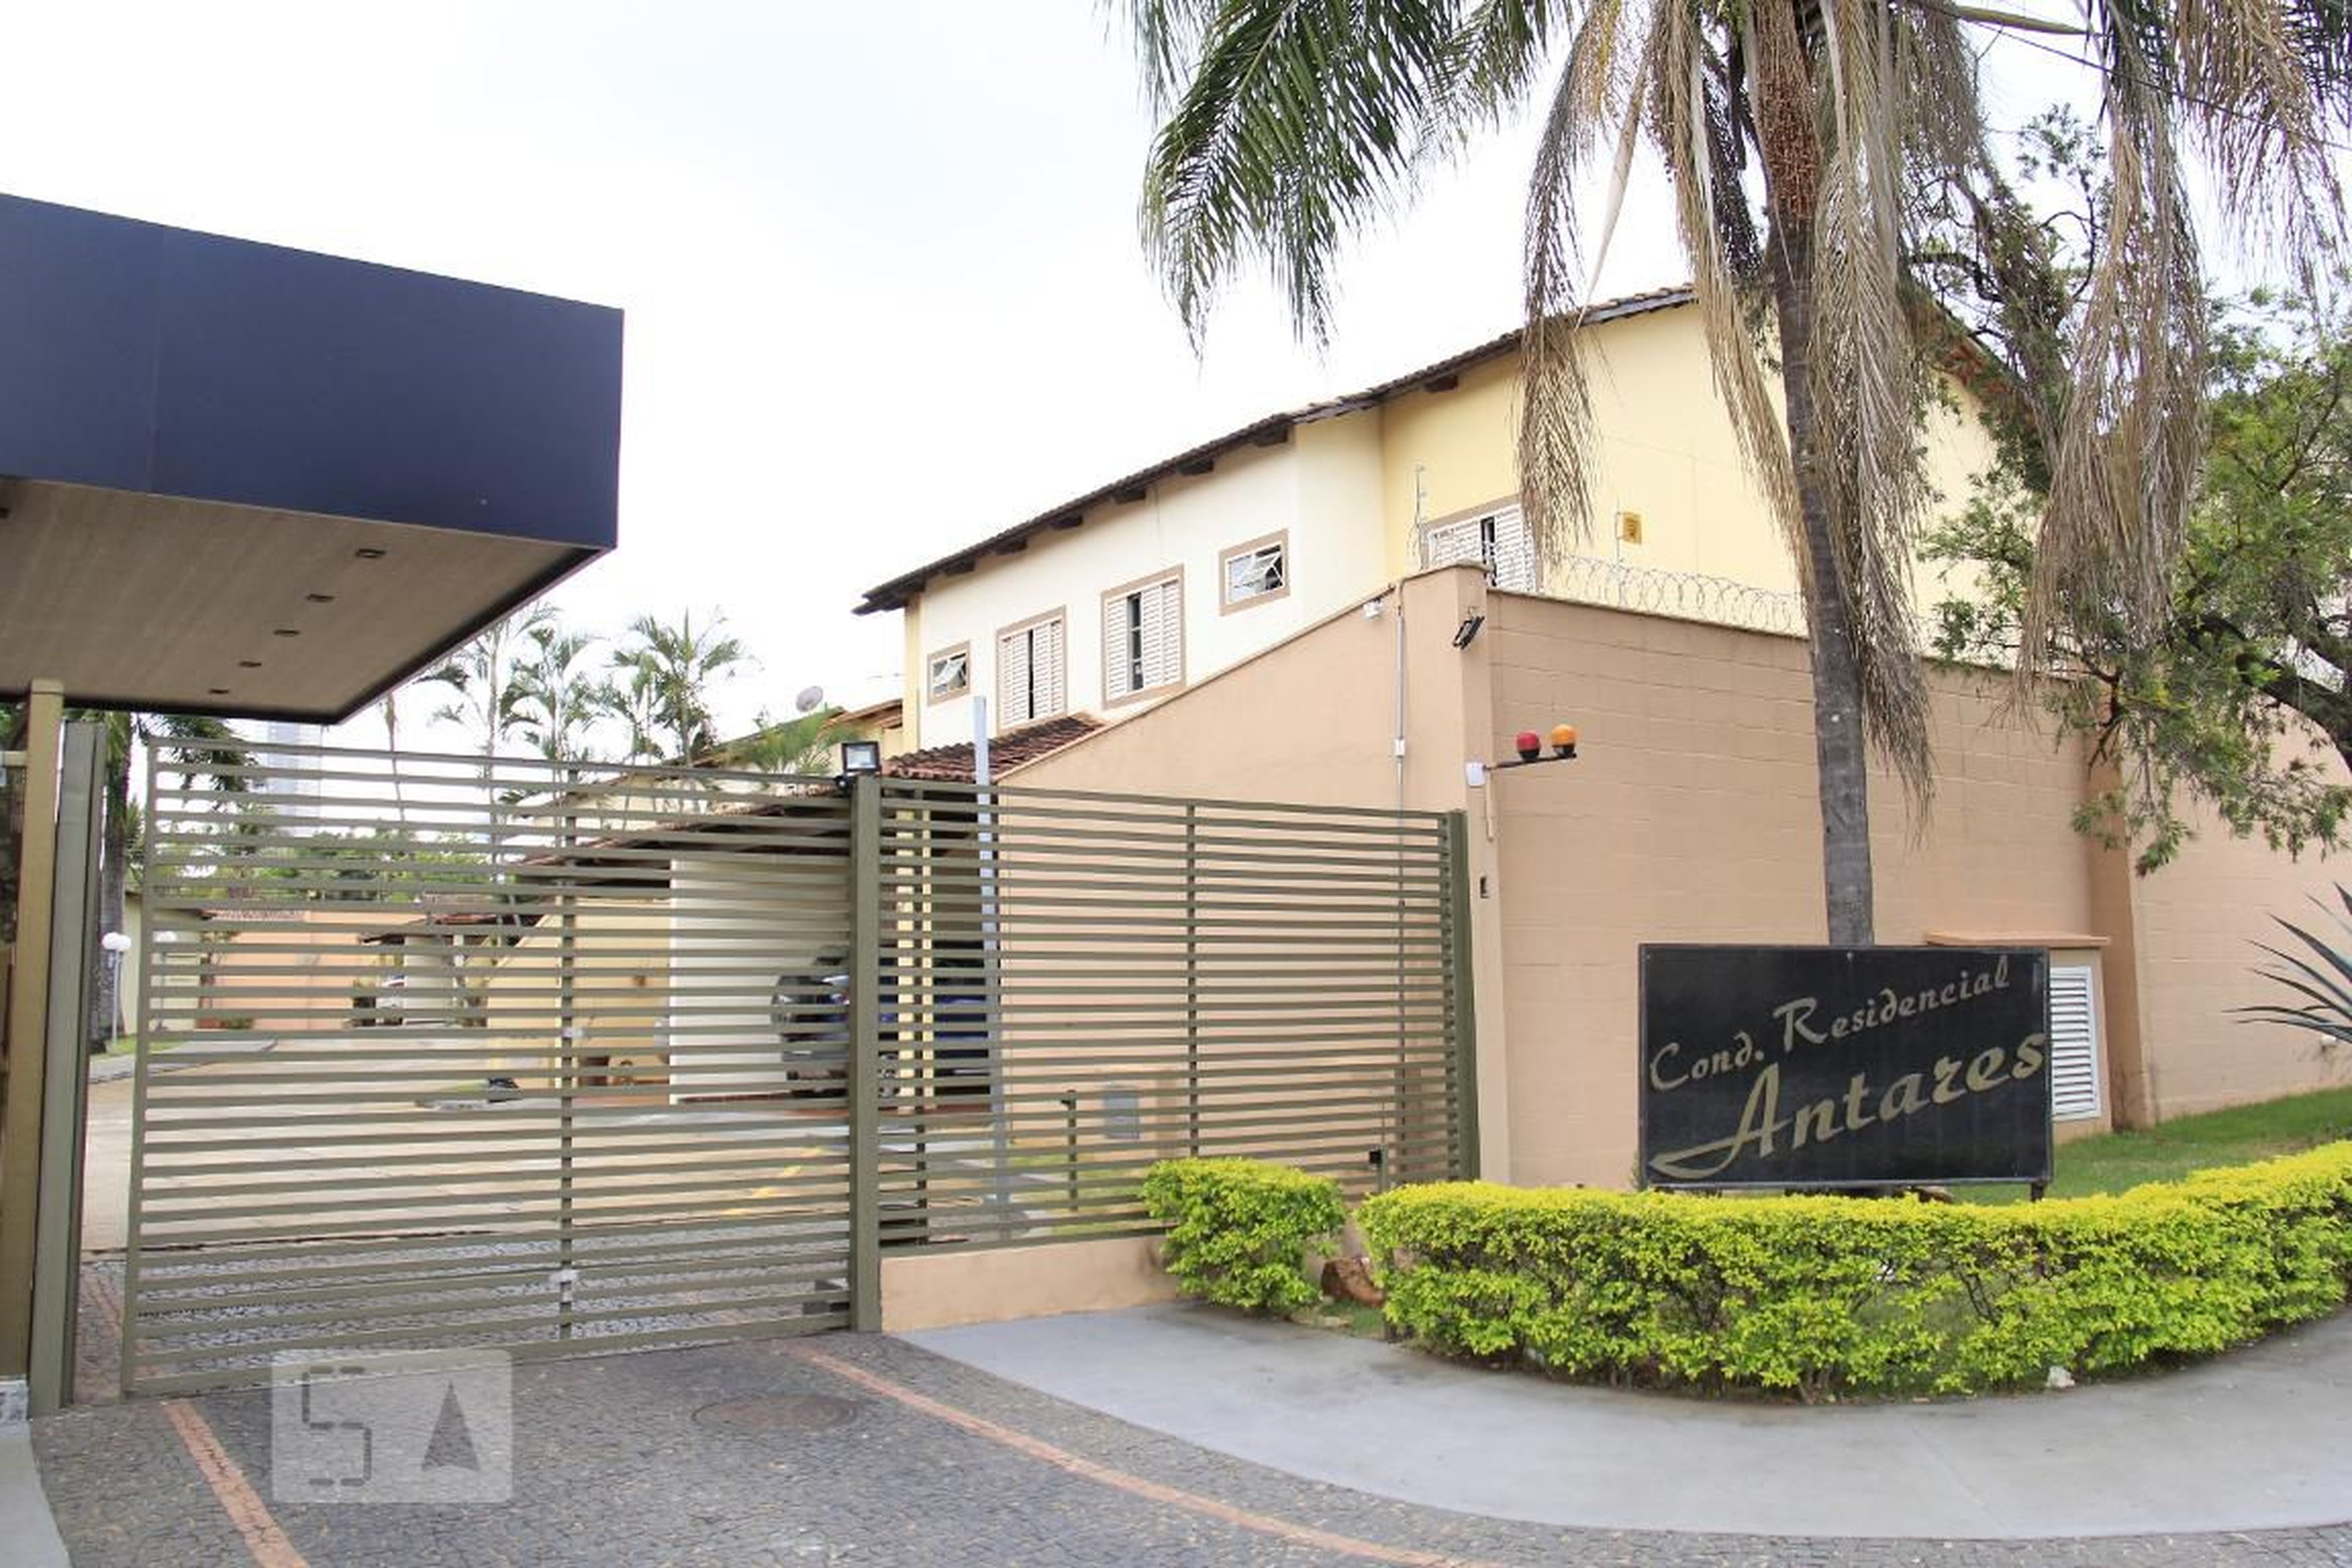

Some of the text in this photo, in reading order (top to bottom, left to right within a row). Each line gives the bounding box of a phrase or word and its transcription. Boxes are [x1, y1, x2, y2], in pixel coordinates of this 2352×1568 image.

[1650, 956, 2010, 1090] Cond. Residencial
[1650, 1033, 2048, 1179] Antares
